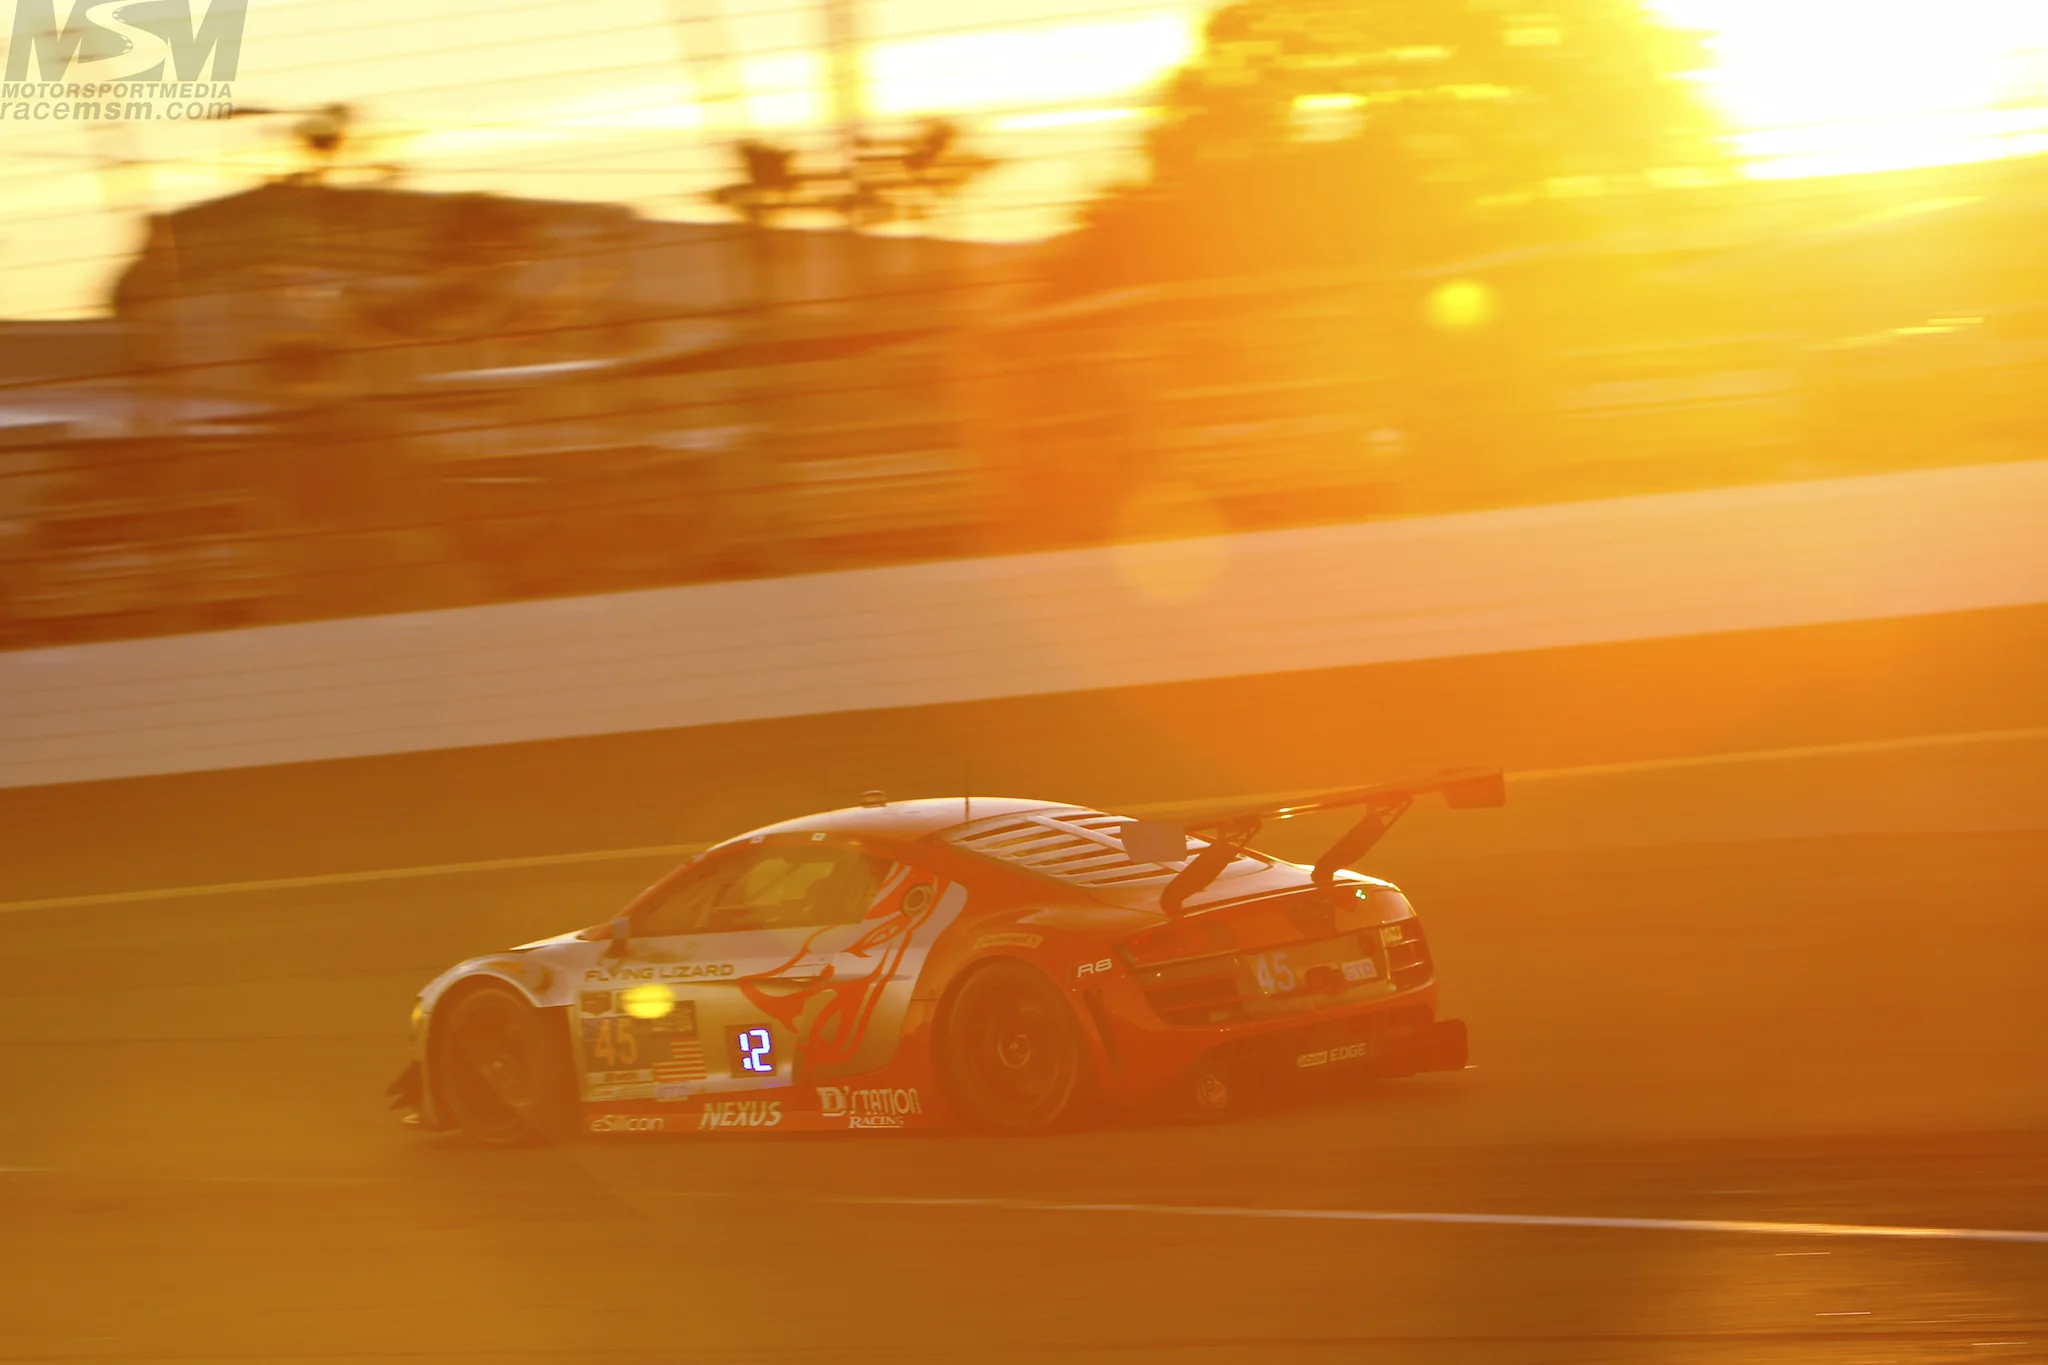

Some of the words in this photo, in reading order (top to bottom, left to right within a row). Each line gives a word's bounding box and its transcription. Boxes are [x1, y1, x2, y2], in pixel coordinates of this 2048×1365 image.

[585, 968, 654, 983] FLYING
[659, 964, 735, 980] LIZARD
[1077, 958, 1113, 978] R8
[1257, 952, 1295, 994] 45
[593, 1019, 638, 1067] 45
[1330, 1042, 1368, 1062] EDGE
[591, 1114, 665, 1132] eScon
[700, 1101, 783, 1130] NEXUS
